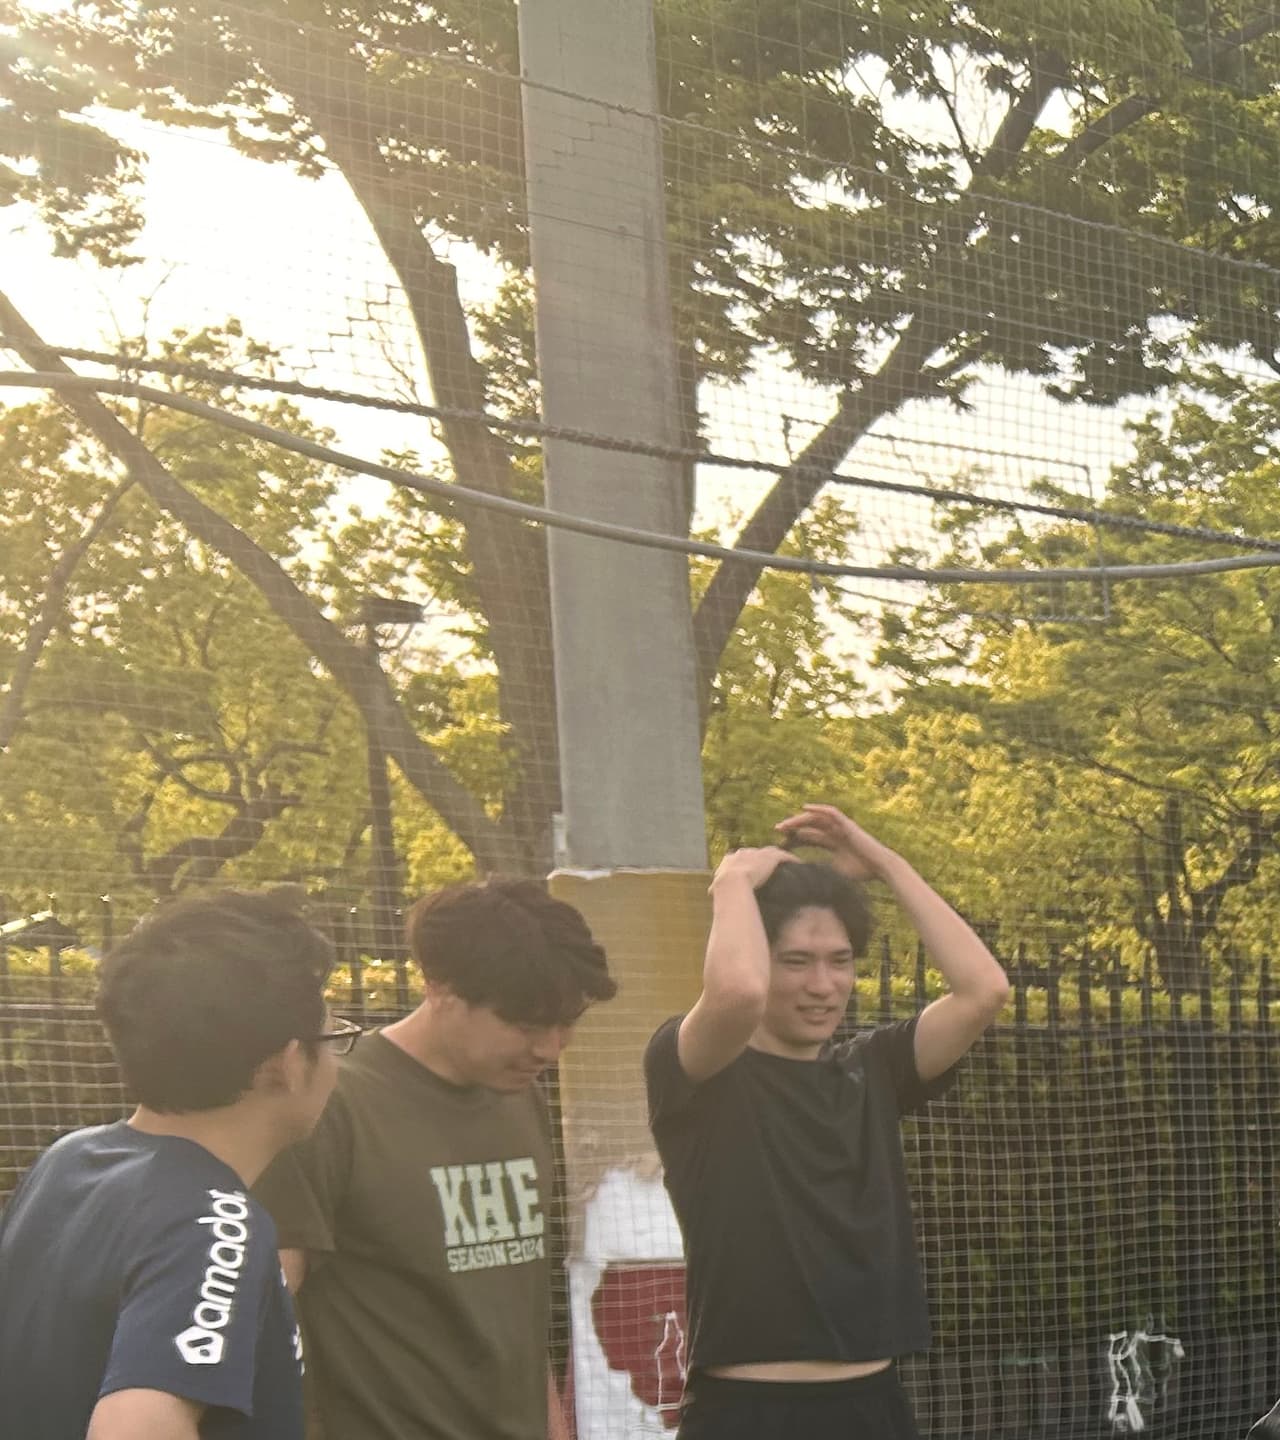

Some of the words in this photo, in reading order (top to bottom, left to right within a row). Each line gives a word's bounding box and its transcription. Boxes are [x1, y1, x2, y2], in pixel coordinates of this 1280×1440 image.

[430, 1156, 545, 1248] KHE
[192, 1187, 250, 1330] amador
[447, 1240, 508, 1273] SEASON
